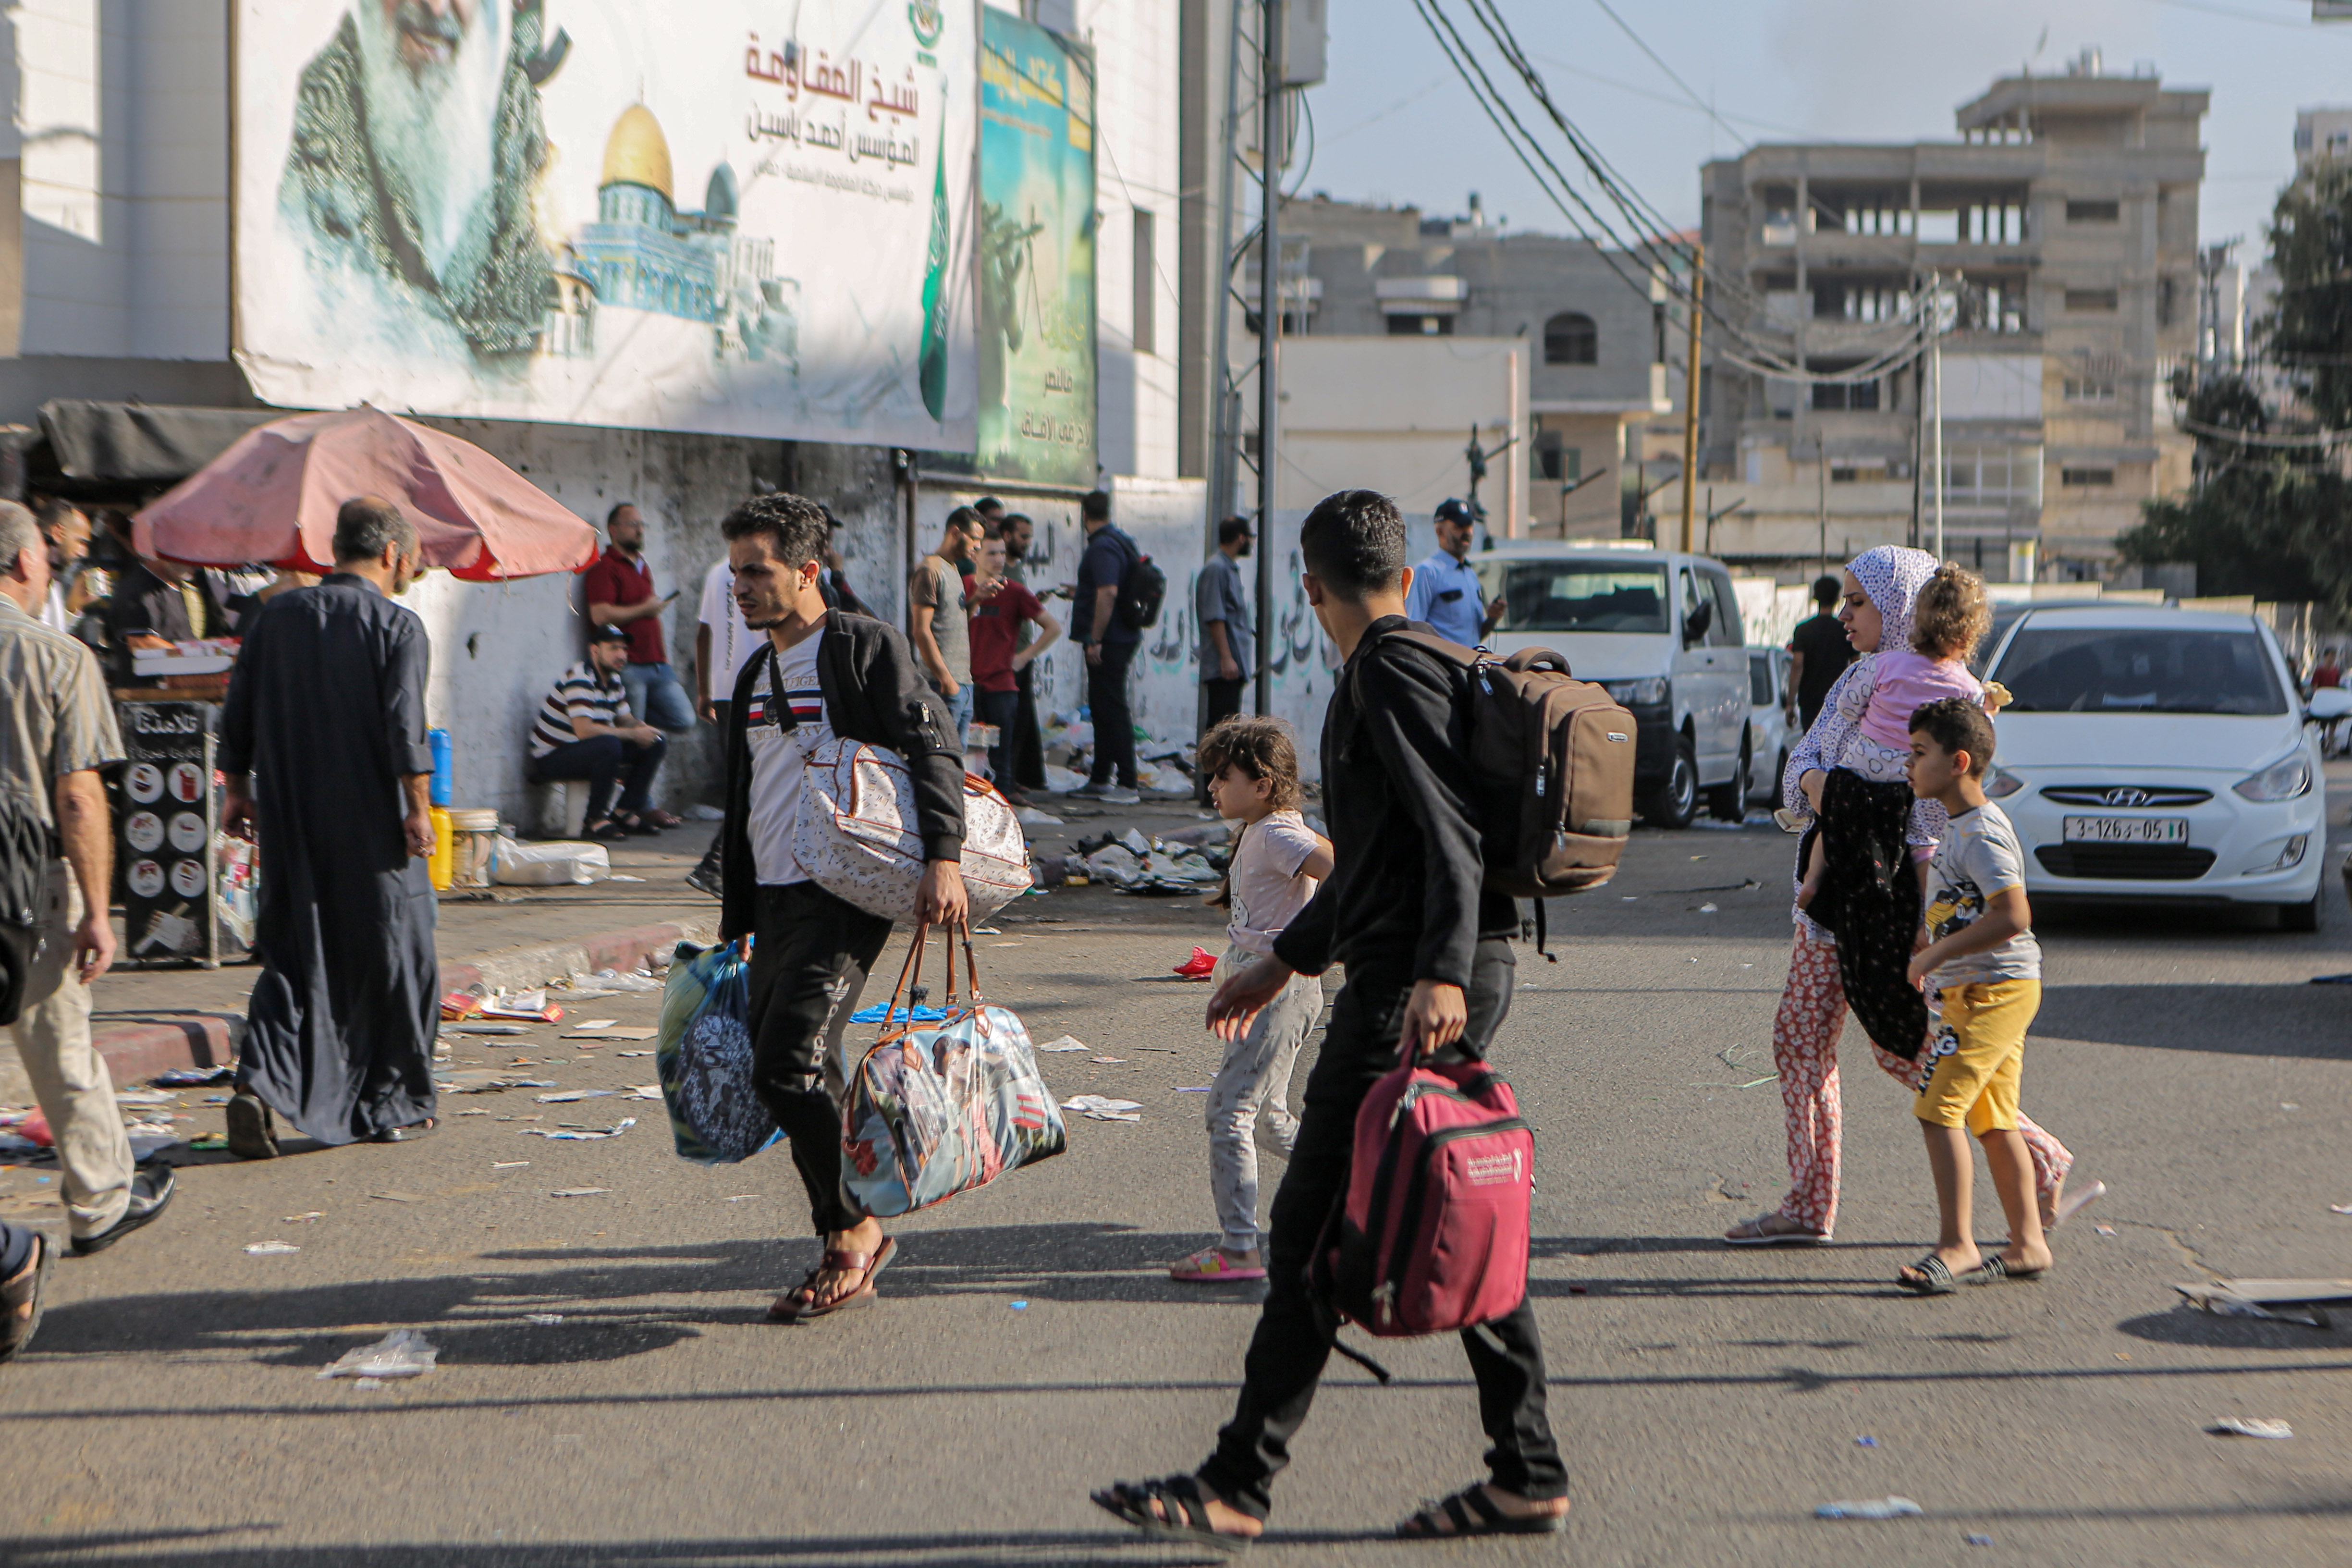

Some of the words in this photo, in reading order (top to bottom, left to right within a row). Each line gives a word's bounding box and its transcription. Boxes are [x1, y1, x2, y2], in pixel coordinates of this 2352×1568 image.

[746, 31, 861, 104] المقاومة
[868, 62, 918, 124] شيخ
[748, 99, 800, 149] ياسين
[805, 105, 845, 150] أحمد
[849, 125, 919, 170] المؤسس
[1059, 416, 1075, 450] في
